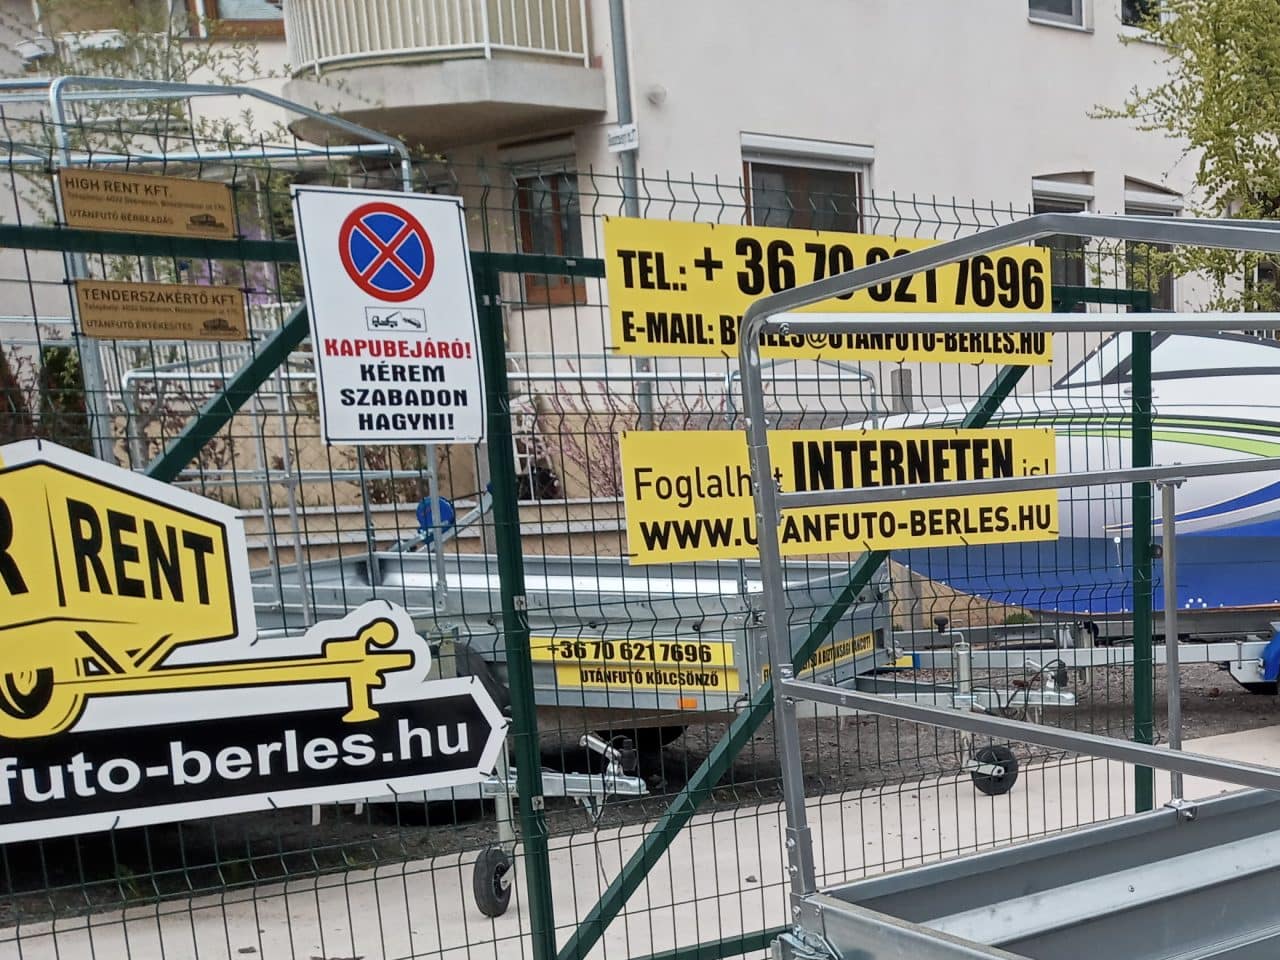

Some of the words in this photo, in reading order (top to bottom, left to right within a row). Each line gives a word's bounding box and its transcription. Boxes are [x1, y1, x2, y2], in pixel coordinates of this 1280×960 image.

[65, 177, 100, 192] HIGH
[104, 181, 140, 195] RENT
[617, 249, 688, 292] TEL.:
[735, 237, 796, 296] 36
[804, 242, 855, 301] 70
[955, 254, 1045, 310] 7696
[621, 310, 715, 345] E-MAIL:
[324, 337, 472, 359] KAPUBEJÁRÓ!
[360, 361, 446, 383] KÉREM
[340, 388, 468, 407] SZABADON
[358, 413, 455, 431] HAGYNI!
[634, 465, 784, 508] Foglalht
[792, 438, 1015, 492] INTERNETEN
[640, 504, 1051, 551] WWW.UANFUTO-BERLES.HU
[66, 496, 215, 606] RENT
[593, 641, 614, 660] 70
[620, 643, 655, 662] 621
[659, 644, 712, 663] 7696
